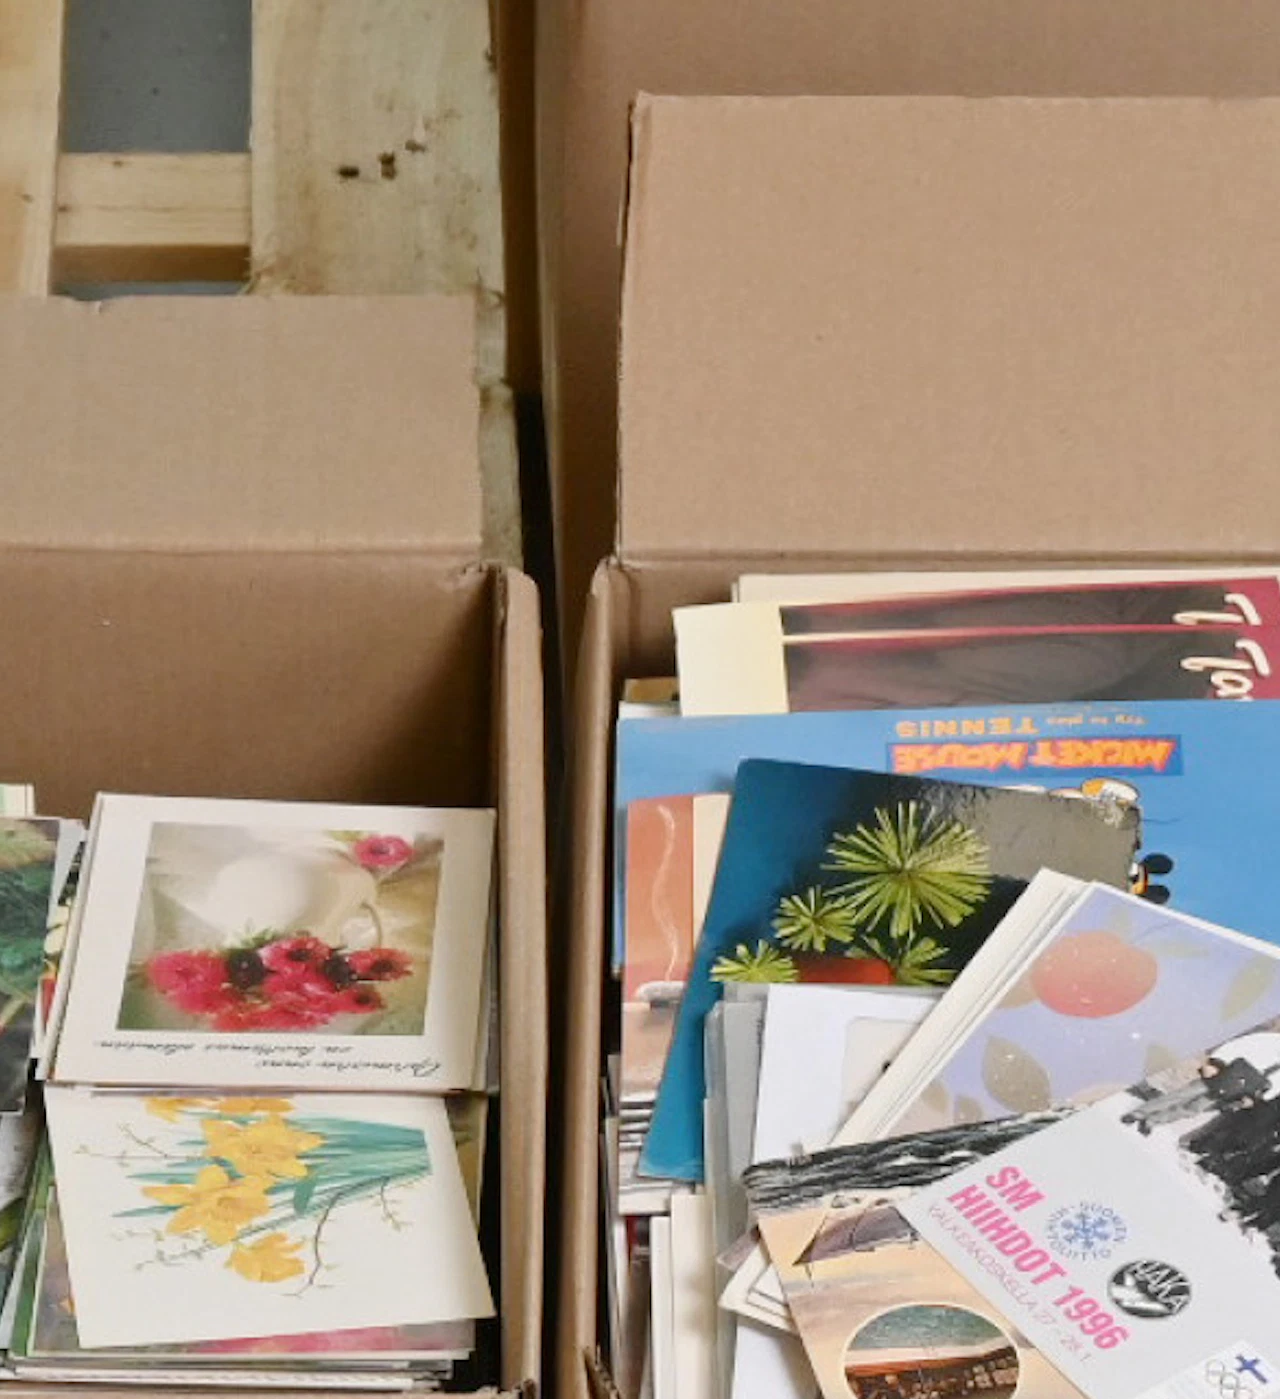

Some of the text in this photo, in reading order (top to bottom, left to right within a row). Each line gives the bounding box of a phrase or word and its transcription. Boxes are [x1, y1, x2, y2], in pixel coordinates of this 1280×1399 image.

[896, 716, 1040, 738] TENNIS
[892, 742, 1028, 774] MOUSE
[985, 1165, 1046, 1213] SM
[946, 1184, 1130, 1350] HIIHDOT 1996
